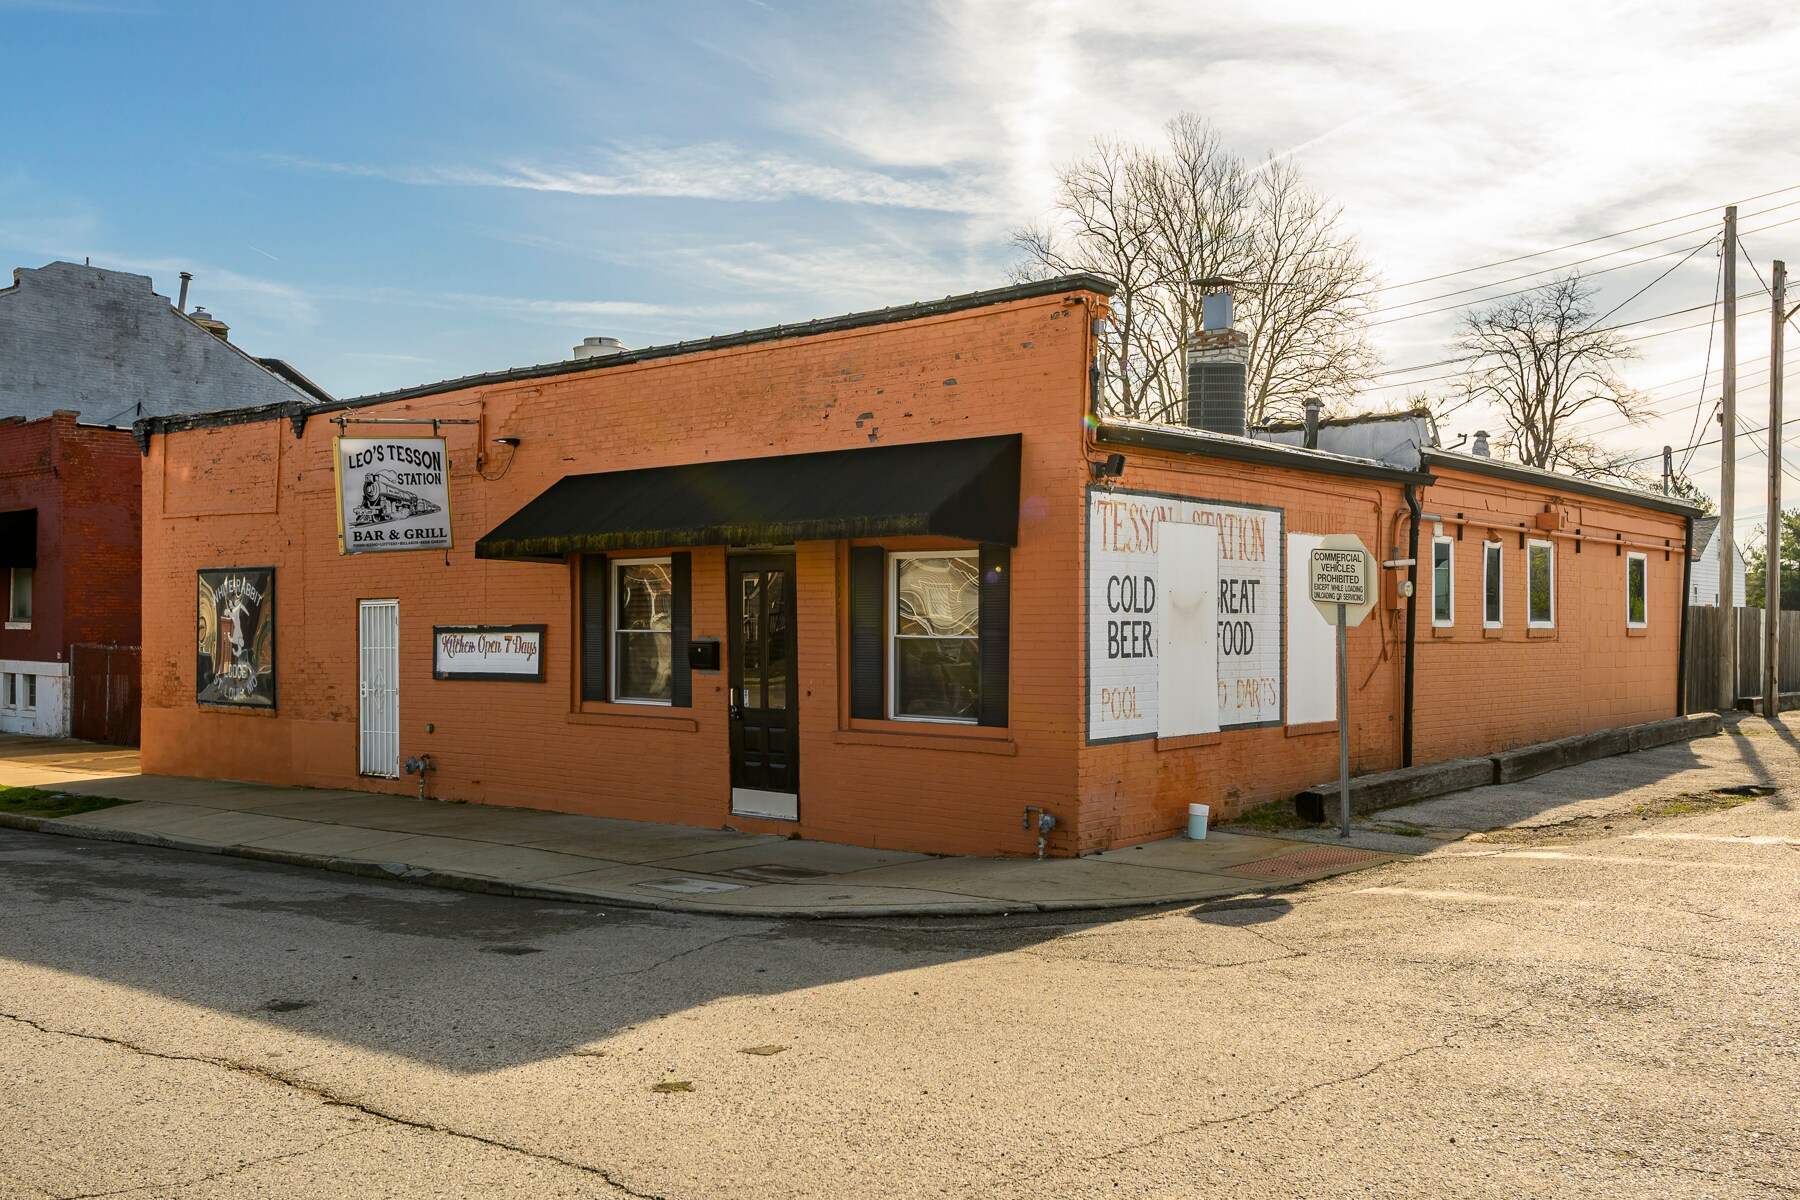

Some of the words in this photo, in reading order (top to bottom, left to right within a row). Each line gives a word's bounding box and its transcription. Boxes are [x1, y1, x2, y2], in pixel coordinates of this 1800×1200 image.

[348, 445, 385, 469] LEO'S
[387, 445, 442, 472] TESSON
[397, 472, 442, 485] STATION
[353, 530, 385, 542] BAR
[389, 529, 401, 540] &
[404, 528, 448, 539] GRILL
[1192, 510, 1266, 562] ATION
[1314, 552, 1362, 562] COMMERCIAL
[1321, 563, 1356, 573] VEHICLES
[1314, 583, 1330, 591] EXCEPT
[1331, 584, 1344, 592] WHILE
[1345, 585, 1363, 593] LOADING
[1317, 574, 1360, 584] PROHIBITED
[236, 579, 264, 607] RABBIT
[1107, 575, 1156, 614] COLD
[1217, 579, 1260, 614] REAT
[1314, 591, 1335, 600] UNLOADING
[1343, 593, 1363, 602] SERVICING
[442, 634, 476, 658] Kitchen
[478, 634, 502, 659] Open
[504, 635, 512, 653] 7
[513, 635, 537, 661] Days
[1108, 620, 1153, 659] BEER
[1101, 687, 1142, 722] POOL
[1236, 678, 1276, 708] DARTS
